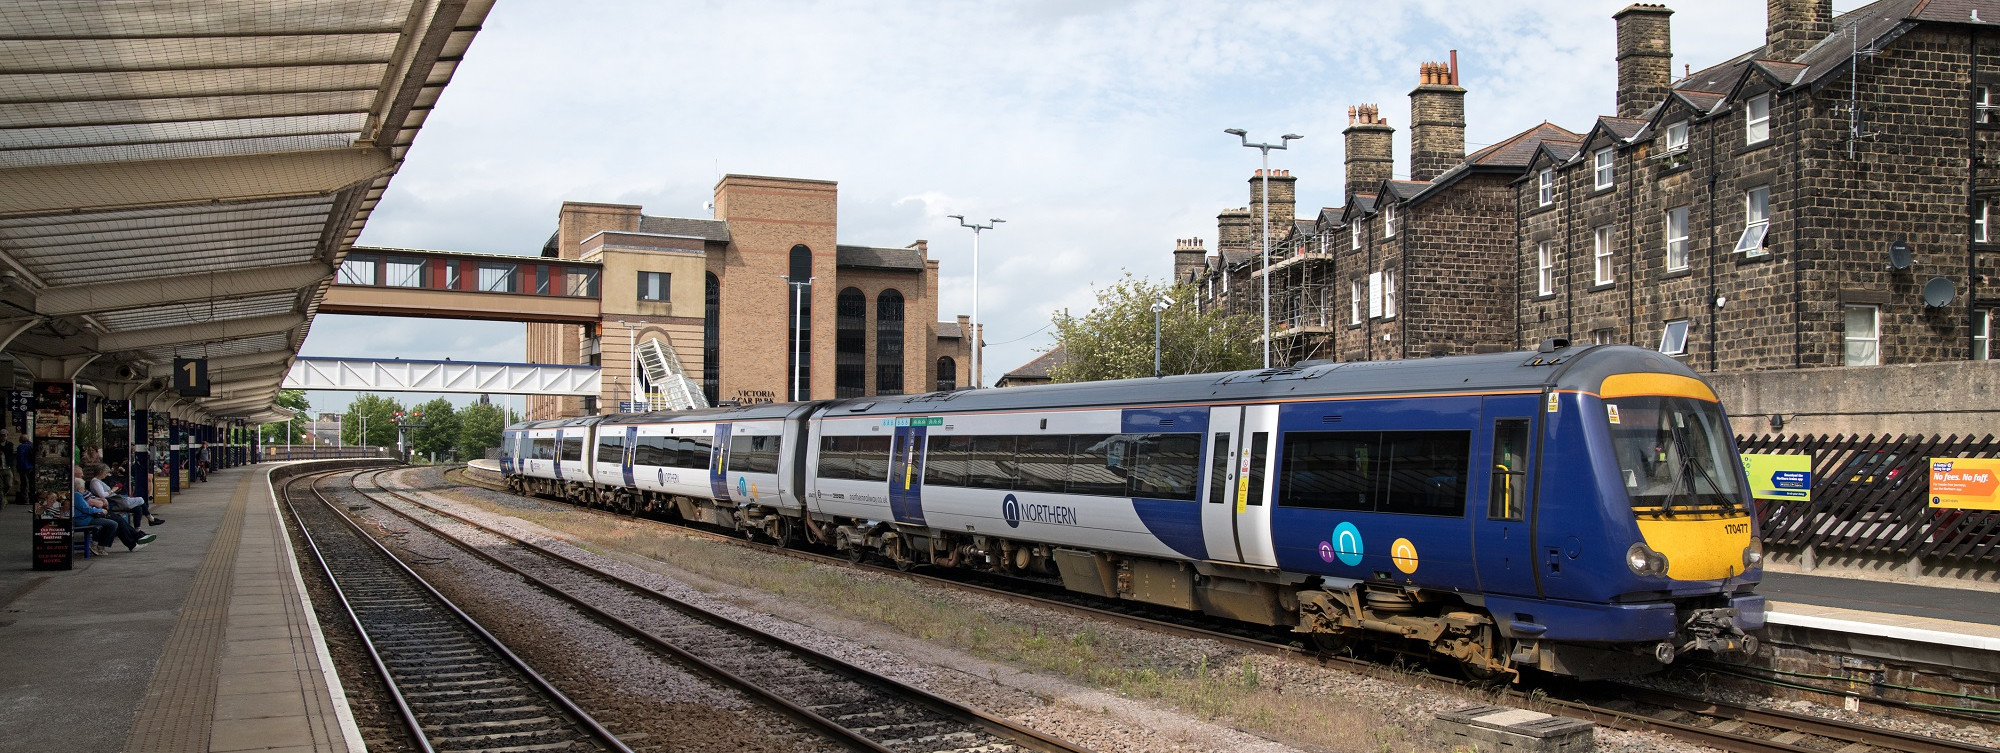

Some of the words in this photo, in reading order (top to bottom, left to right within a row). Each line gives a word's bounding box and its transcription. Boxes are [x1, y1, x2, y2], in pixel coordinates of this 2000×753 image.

[182, 361, 196, 387] 1
[738, 390, 776, 398] VICTORIA
[1943, 473, 1961, 482] fees.
[1962, 473, 1973, 481] No
[1972, 473, 1989, 483] faff.
[1021, 503, 1077, 525] NORTHERN
[1724, 523, 1748, 534] 170477
